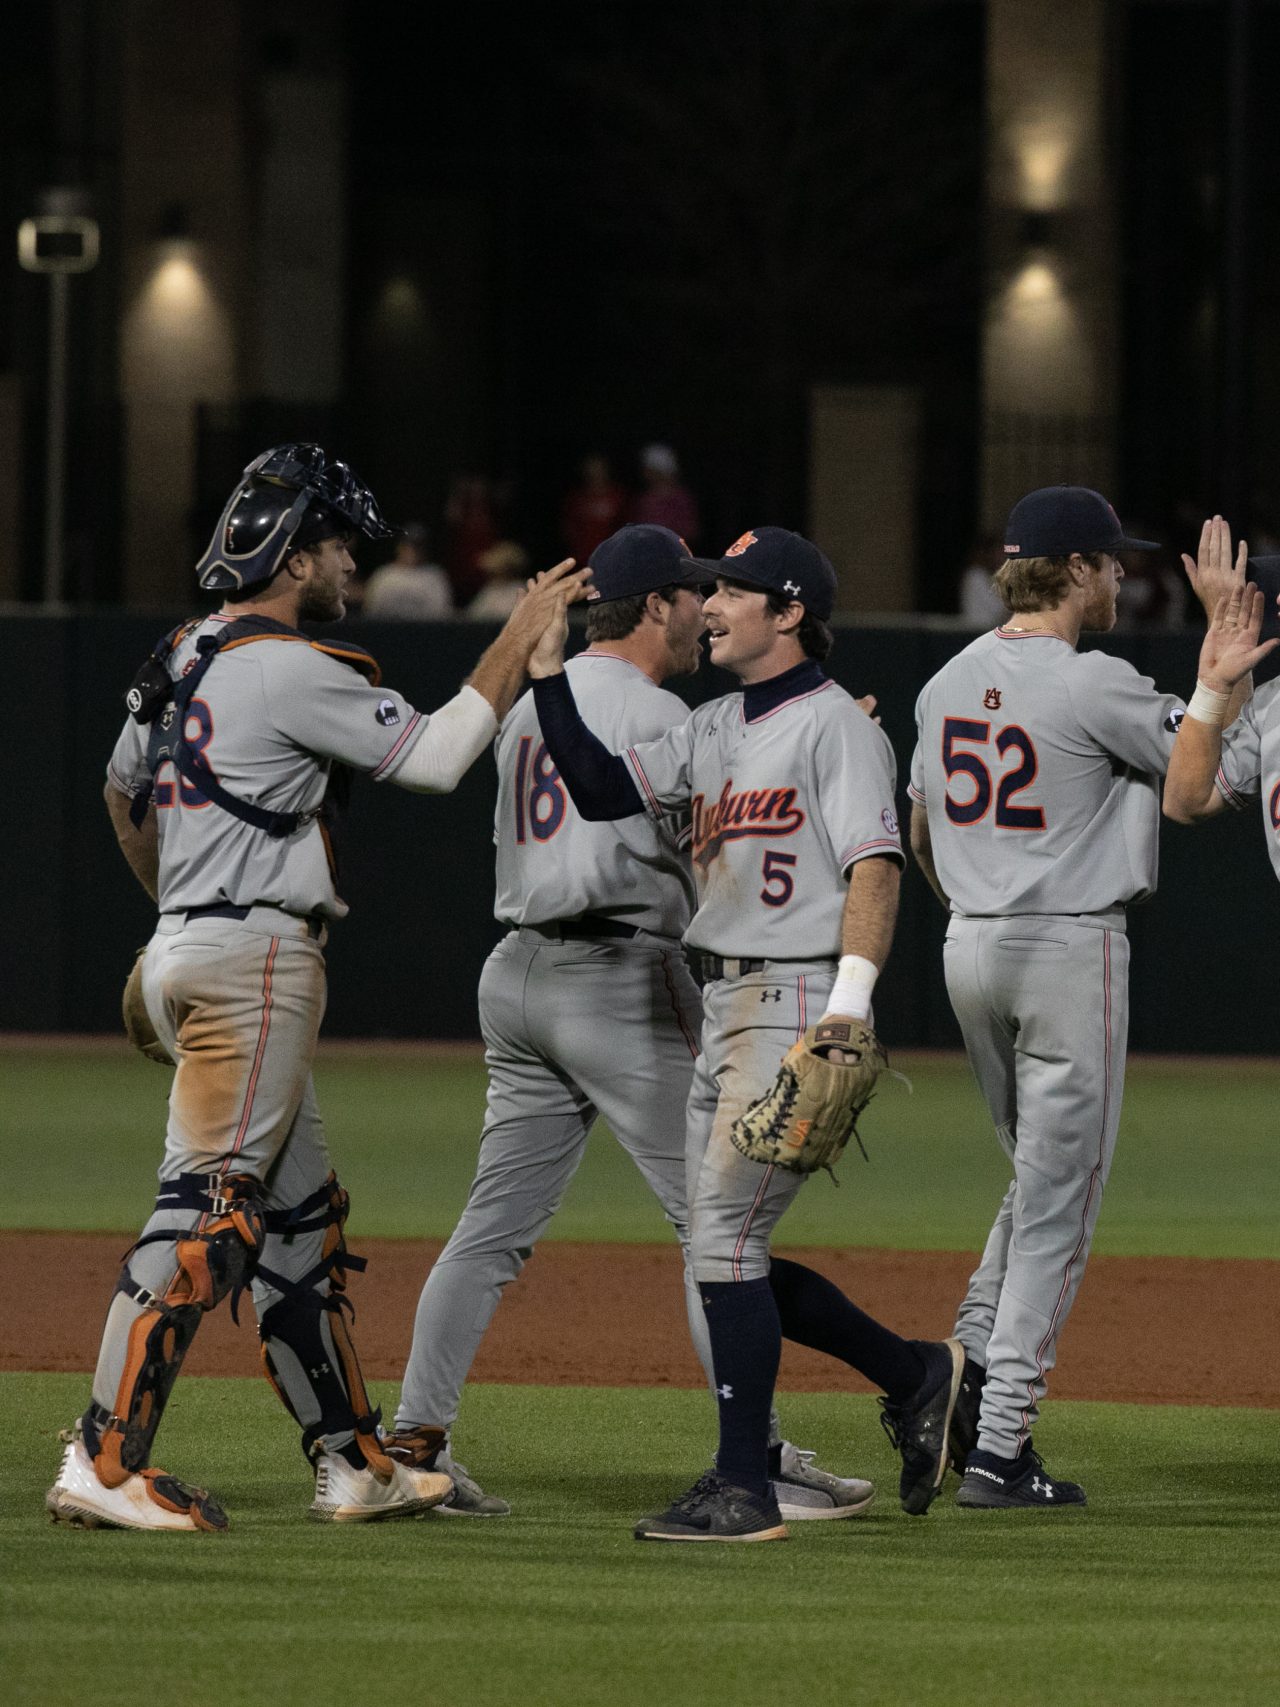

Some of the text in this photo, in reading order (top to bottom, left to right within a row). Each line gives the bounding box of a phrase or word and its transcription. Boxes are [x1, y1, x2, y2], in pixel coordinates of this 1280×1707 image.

[515, 736, 567, 845] 18
[942, 716, 1047, 831] 52
[760, 850, 797, 907] 5
[970, 1467, 1005, 1485] ARMOUR
